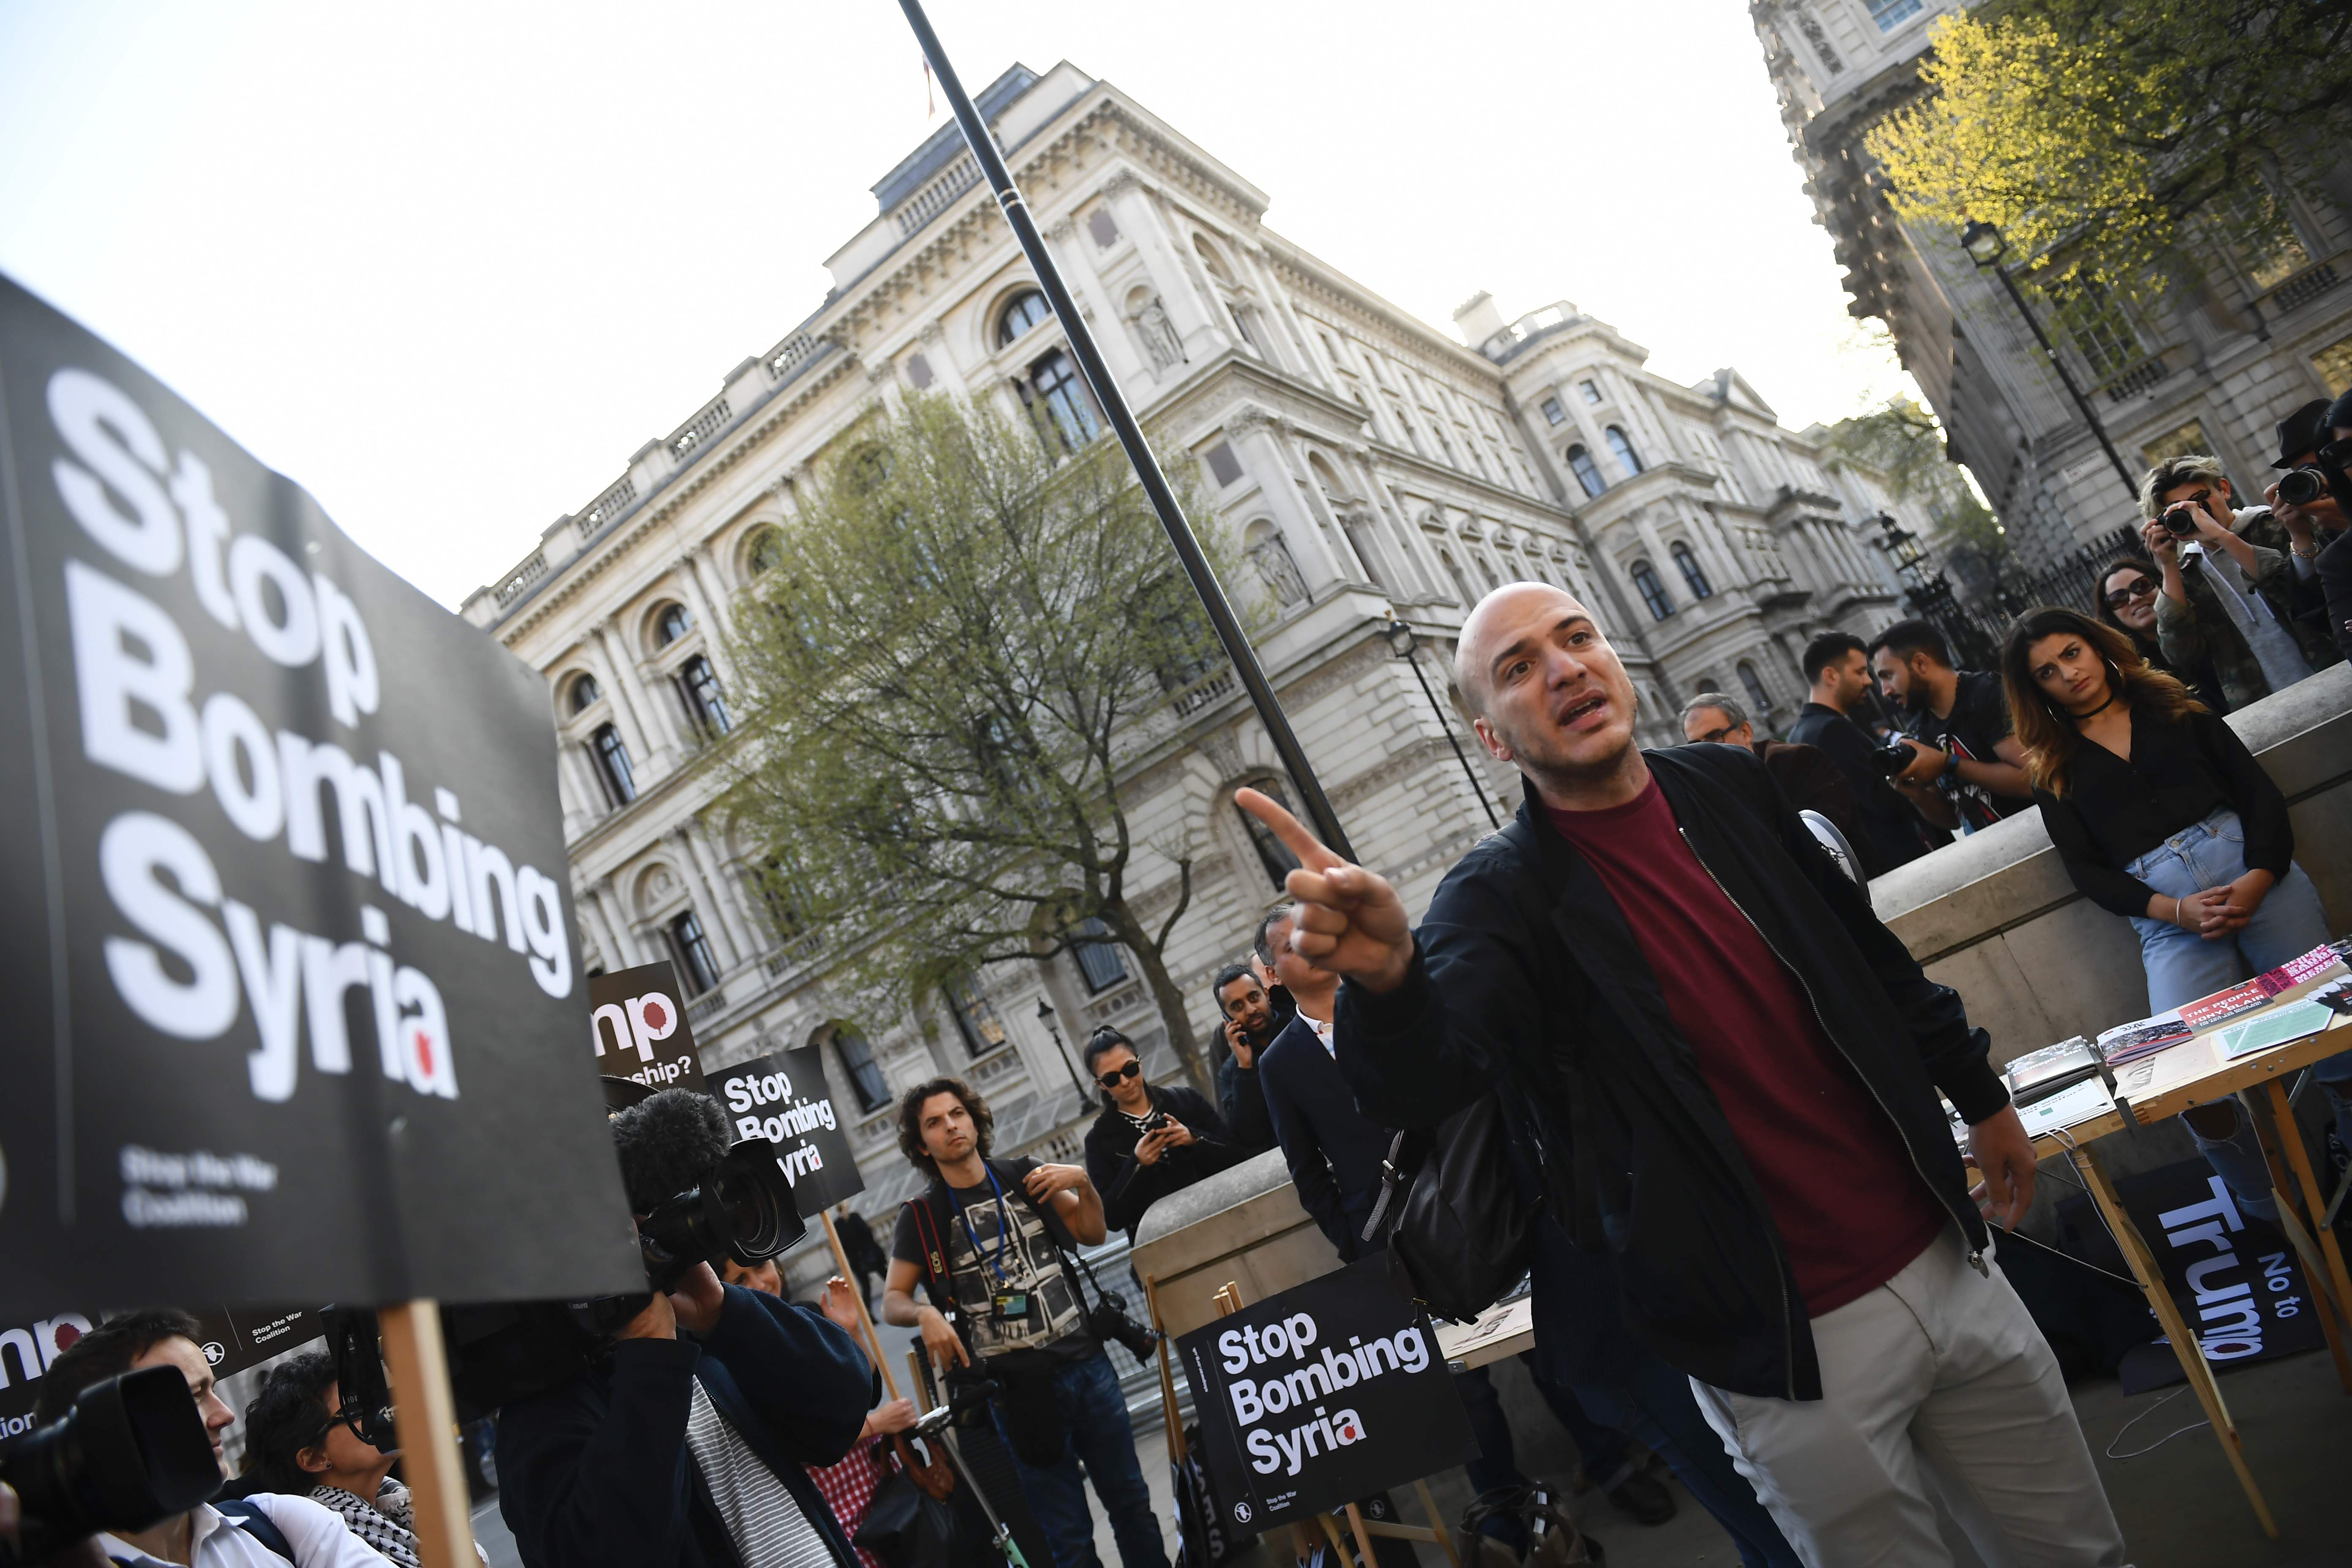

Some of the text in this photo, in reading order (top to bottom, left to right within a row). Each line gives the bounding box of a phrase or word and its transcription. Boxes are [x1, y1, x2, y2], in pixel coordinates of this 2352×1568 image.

[46, 367, 379, 729] Stop
[63, 558, 573, 999] Bombing
[100, 810, 460, 1103] Syria
[2281, 943, 2327, 969] BEHIND
[2186, 1007, 2210, 1018] THE
[2212, 988, 2259, 1008] PEOPLE
[2190, 1010, 2223, 1024] TONY
[2227, 994, 2265, 1011] BLAIR
[724, 1072, 792, 1113] Stop
[735, 1097, 836, 1143] Bombing
[776, 1139, 823, 1189] yria
[930, 1251, 943, 1273] EOS
[2158, 1175, 2263, 1360] Trump
[2257, 1252, 2300, 1318] No to
[252, 1311, 302, 1336] Stop the War
[255, 1326, 291, 1344] Coalition
[1219, 1312, 1317, 1375] Stop
[1192, 1347, 1208, 1393] stopwar.org.uk
[1229, 1326, 1430, 1427] Bombing
[1247, 1406, 1367, 1476] Syria
[1269, 1502, 1290, 1511] Coalition
